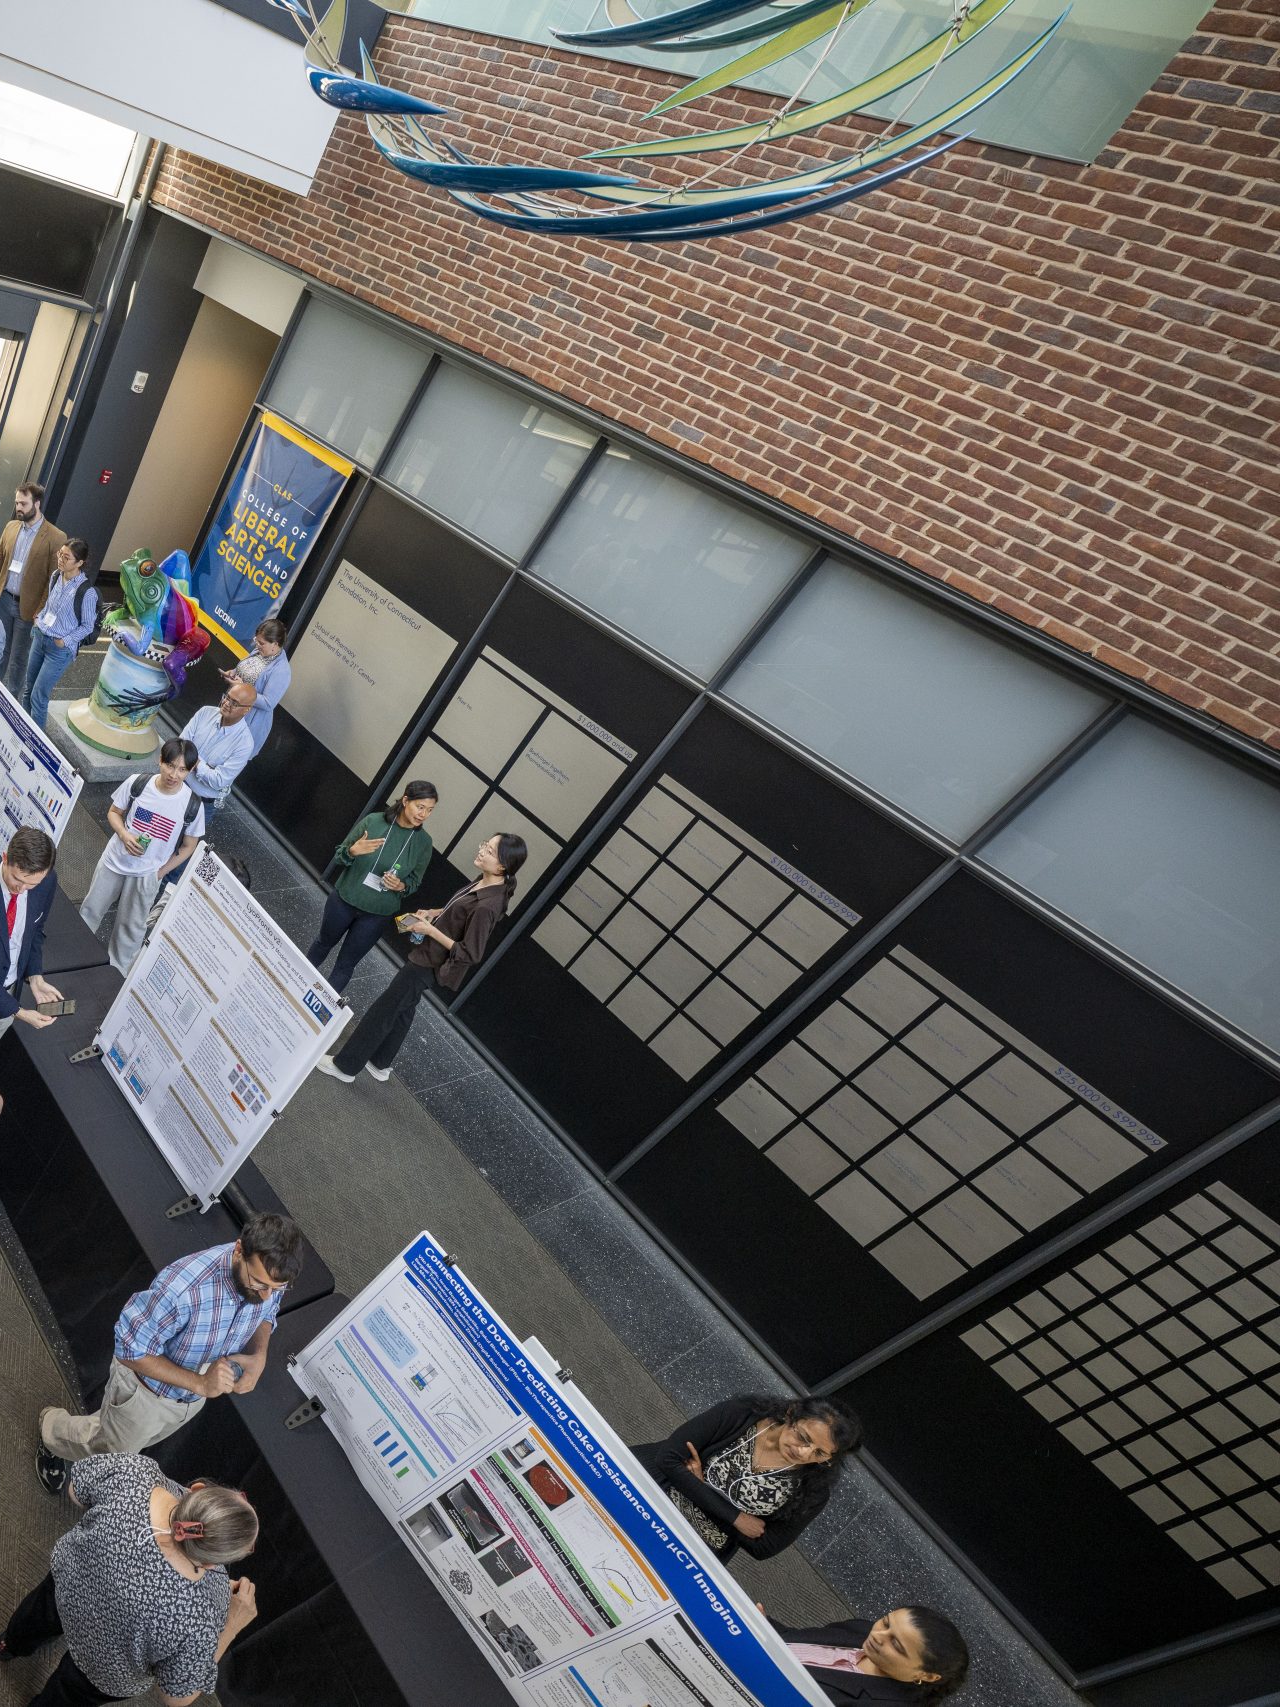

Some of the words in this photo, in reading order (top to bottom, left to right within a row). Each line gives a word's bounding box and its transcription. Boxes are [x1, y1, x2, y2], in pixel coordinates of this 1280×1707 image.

[242, 490, 288, 528] COLLEGE
[292, 526, 308, 540] OF
[274, 484, 293, 501] CLAS
[225, 522, 267, 562] ARTS
[265, 560, 288, 580] AND
[233, 500, 296, 562] LIBERAL
[217, 540, 282, 600] SCIENCES
[214, 604, 238, 630] UCONN
[336, 580, 367, 608] Foundation,
[368, 604, 378, 616] Inc.
[343, 568, 354, 582] The
[353, 576, 380, 603] University
[379, 597, 388, 606] of
[386, 602, 422, 631] Connecticut
[310, 629, 336, 656] Endowment
[358, 668, 376, 686] Century
[314, 622, 331, 638] School
[334, 636, 356, 659] Pharmacy
[577, 714, 612, 743] $1,000,000
[612, 740, 624, 752] and
[624, 750, 633, 759] up
[770, 856, 808, 886] $100,000
[808, 885, 816, 894] to
[818, 891, 858, 921] $999,999
[246, 903, 273, 936] LyoPronto
[305, 991, 322, 1012] LYO
[1055, 1066, 1100, 1102] $25,000
[1100, 1102, 1111, 1112] to
[1113, 1110, 1162, 1146] $99,999
[465, 1327, 477, 1343] Zhang
[476, 1342, 490, 1358] (DigiM
[489, 1358, 509, 1381] Solutions)
[425, 1247, 471, 1304] Connecting
[471, 1305, 488, 1325] the
[487, 1324, 510, 1352] Dots
[516, 1359, 568, 1420] Predicting
[567, 1419, 595, 1452] Cake
[593, 1452, 651, 1520] Resistance
[650, 1520, 669, 1541] via
[666, 1542, 698, 1571] µCT
[694, 1573, 742, 1636] Imaging
[509, 1367, 522, 1382] (Pfizer
[558, 1425, 590, 1464] Pharmaceutical
[589, 1464, 602, 1478] R&D)
[659, 1652, 685, 1681] Connecting
[685, 1680, 693, 1689] the
[693, 1689, 705, 1702] Dots
[708, 1655, 721, 1669] DATA
[720, 1669, 734, 1684] USED
